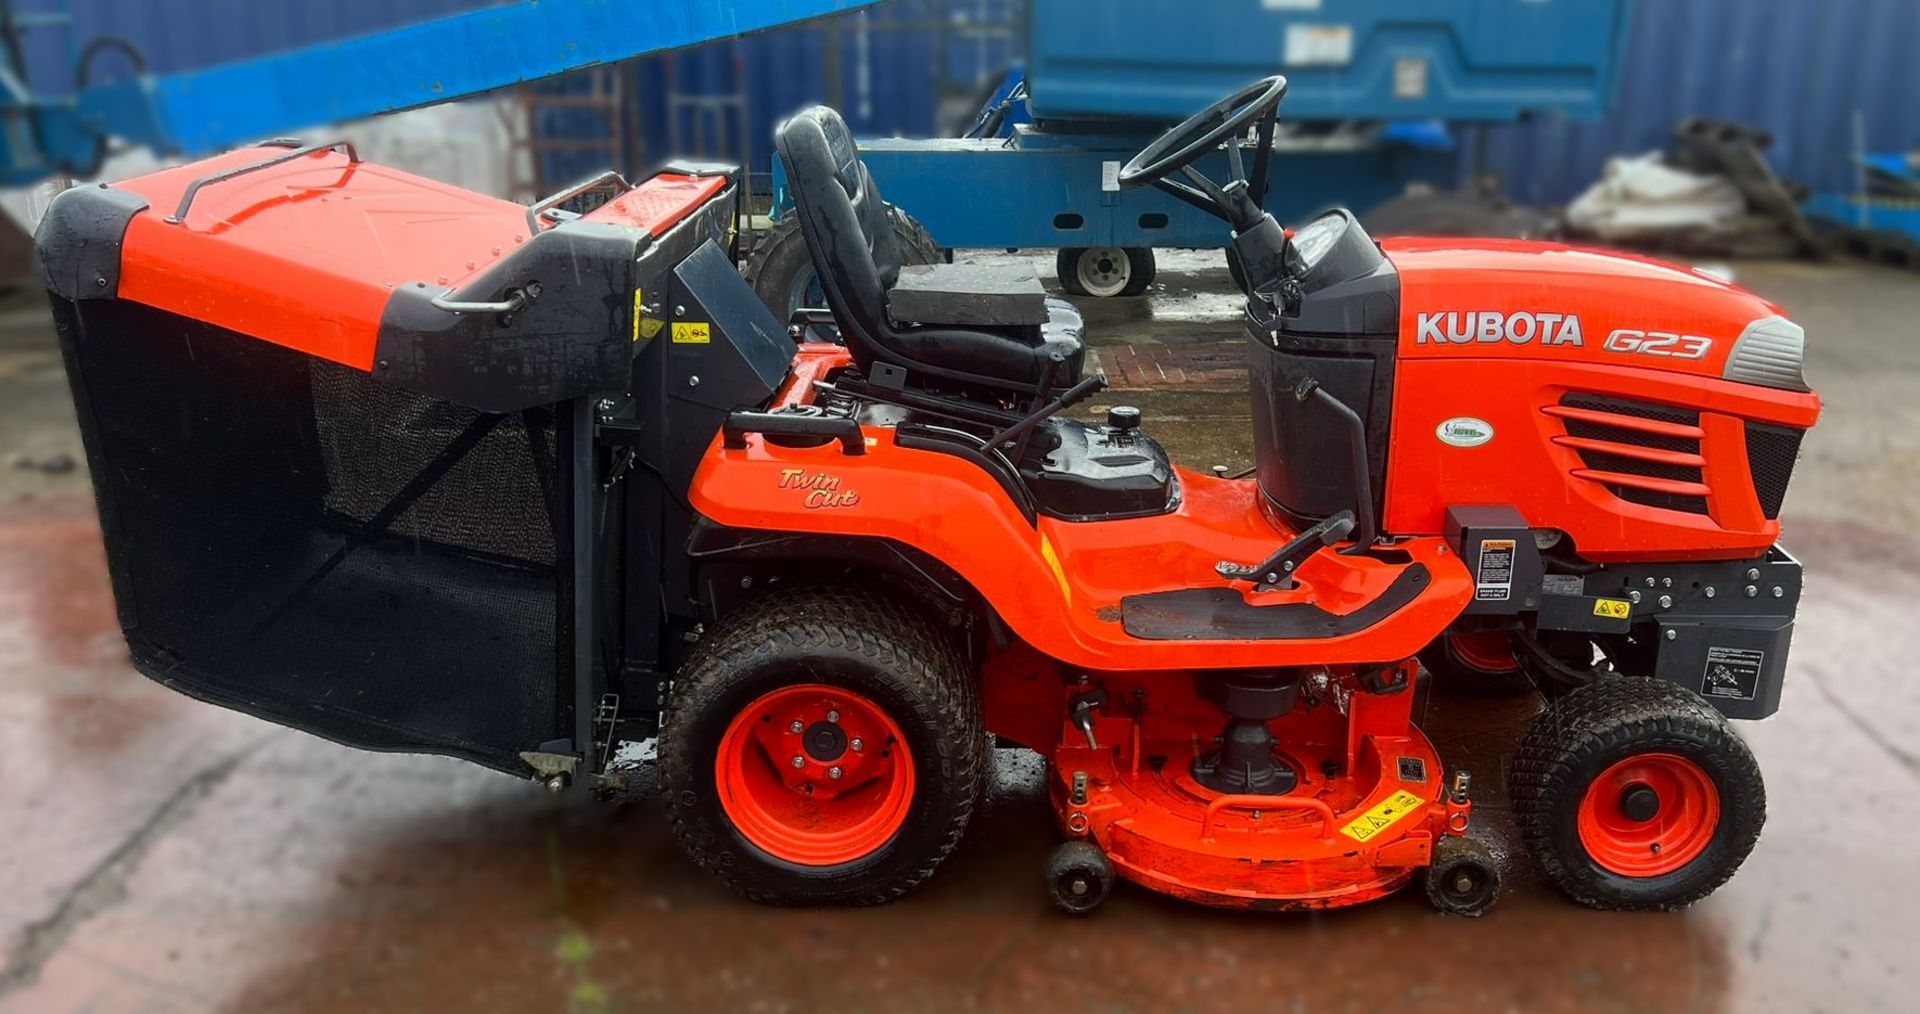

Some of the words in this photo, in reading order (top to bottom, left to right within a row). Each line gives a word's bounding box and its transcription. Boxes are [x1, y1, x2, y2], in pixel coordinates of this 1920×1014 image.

[1417, 311, 1584, 346] KUBOTA
[1602, 329, 1712, 359] G23
[778, 468, 841, 491] Twin
[804, 489, 860, 509] Cut
